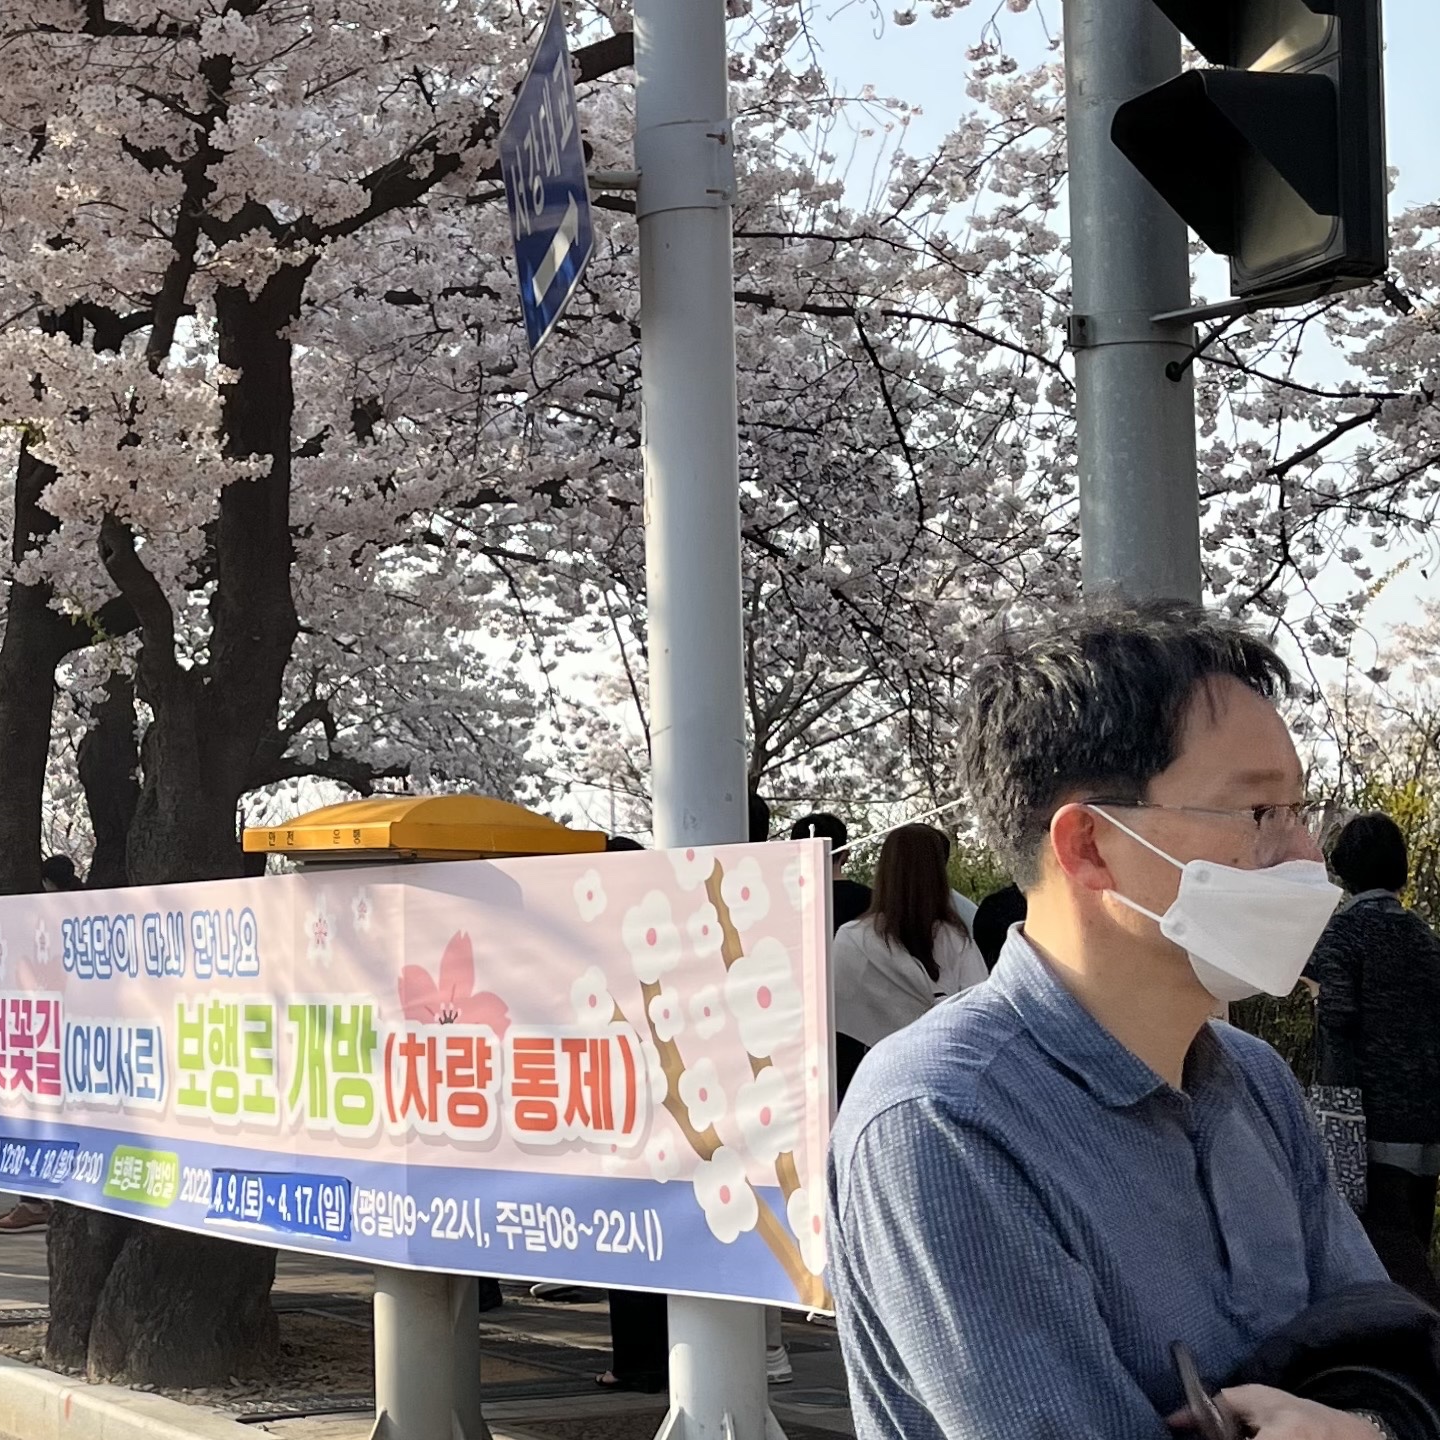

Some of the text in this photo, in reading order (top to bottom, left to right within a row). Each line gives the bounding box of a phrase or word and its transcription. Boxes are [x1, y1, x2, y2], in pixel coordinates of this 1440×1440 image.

[510, 51, 574, 241] 서강대교
[62, 907, 259, 979] 3년만이 다시 만나요
[64, 1021, 165, 1101] (여의서로)
[177, 1000, 276, 1116] 보행로
[287, 1003, 377, 1127] 개방
[384, 1032, 493, 1129] (차량
[511, 1034, 637, 1135] 통제)
[71, 1150, 104, 1184] 12:00
[109, 1155, 144, 1191] 보행로
[142, 1159, 176, 1199] 개방일
